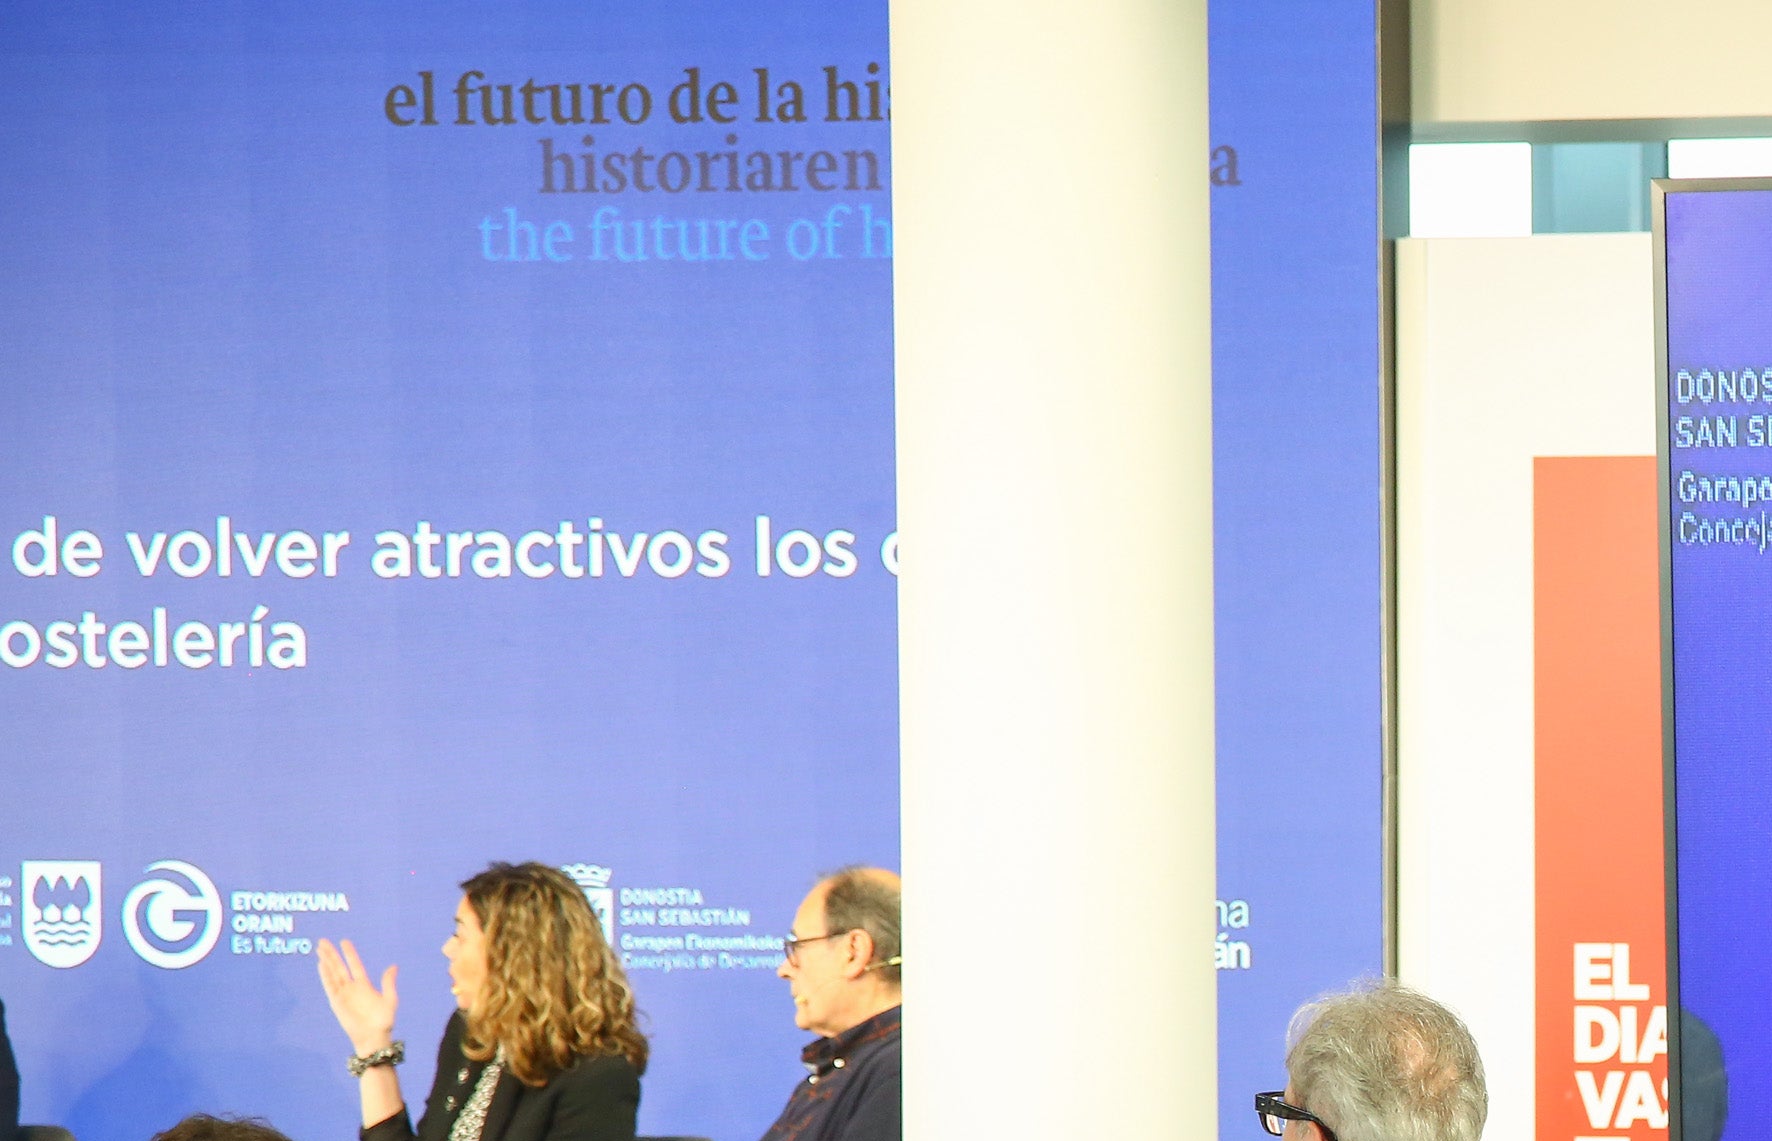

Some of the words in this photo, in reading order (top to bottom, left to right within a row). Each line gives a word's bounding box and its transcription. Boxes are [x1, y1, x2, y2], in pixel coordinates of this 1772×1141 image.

[384, 71, 440, 127] el
[452, 69, 653, 126] futuro
[668, 66, 740, 125] de
[754, 66, 803, 124] la
[824, 61, 891, 122] hi
[538, 134, 883, 195] historiaren
[478, 206, 574, 262] the
[588, 204, 771, 261] future
[785, 203, 852, 260] of
[1675, 414, 1738, 448] SAN
[12, 515, 103, 578] de
[126, 515, 350, 578] volver
[370, 516, 732, 578] atractivos
[755, 515, 858, 578] los
[0, 604, 308, 669] ostelería
[230, 889, 350, 912] ETORKIZUNA
[230, 912, 294, 934] ORAIN
[619, 887, 704, 907] DONOSTIA
[619, 908, 656, 927] SAN
[657, 906, 751, 927] SEBASTIÁN
[230, 933, 253, 955] Es
[253, 934, 313, 955] futuro
[1573, 942, 1651, 1001] EL
[1573, 1004, 1669, 1064] DIA
[1573, 1070, 1670, 1129] VA
